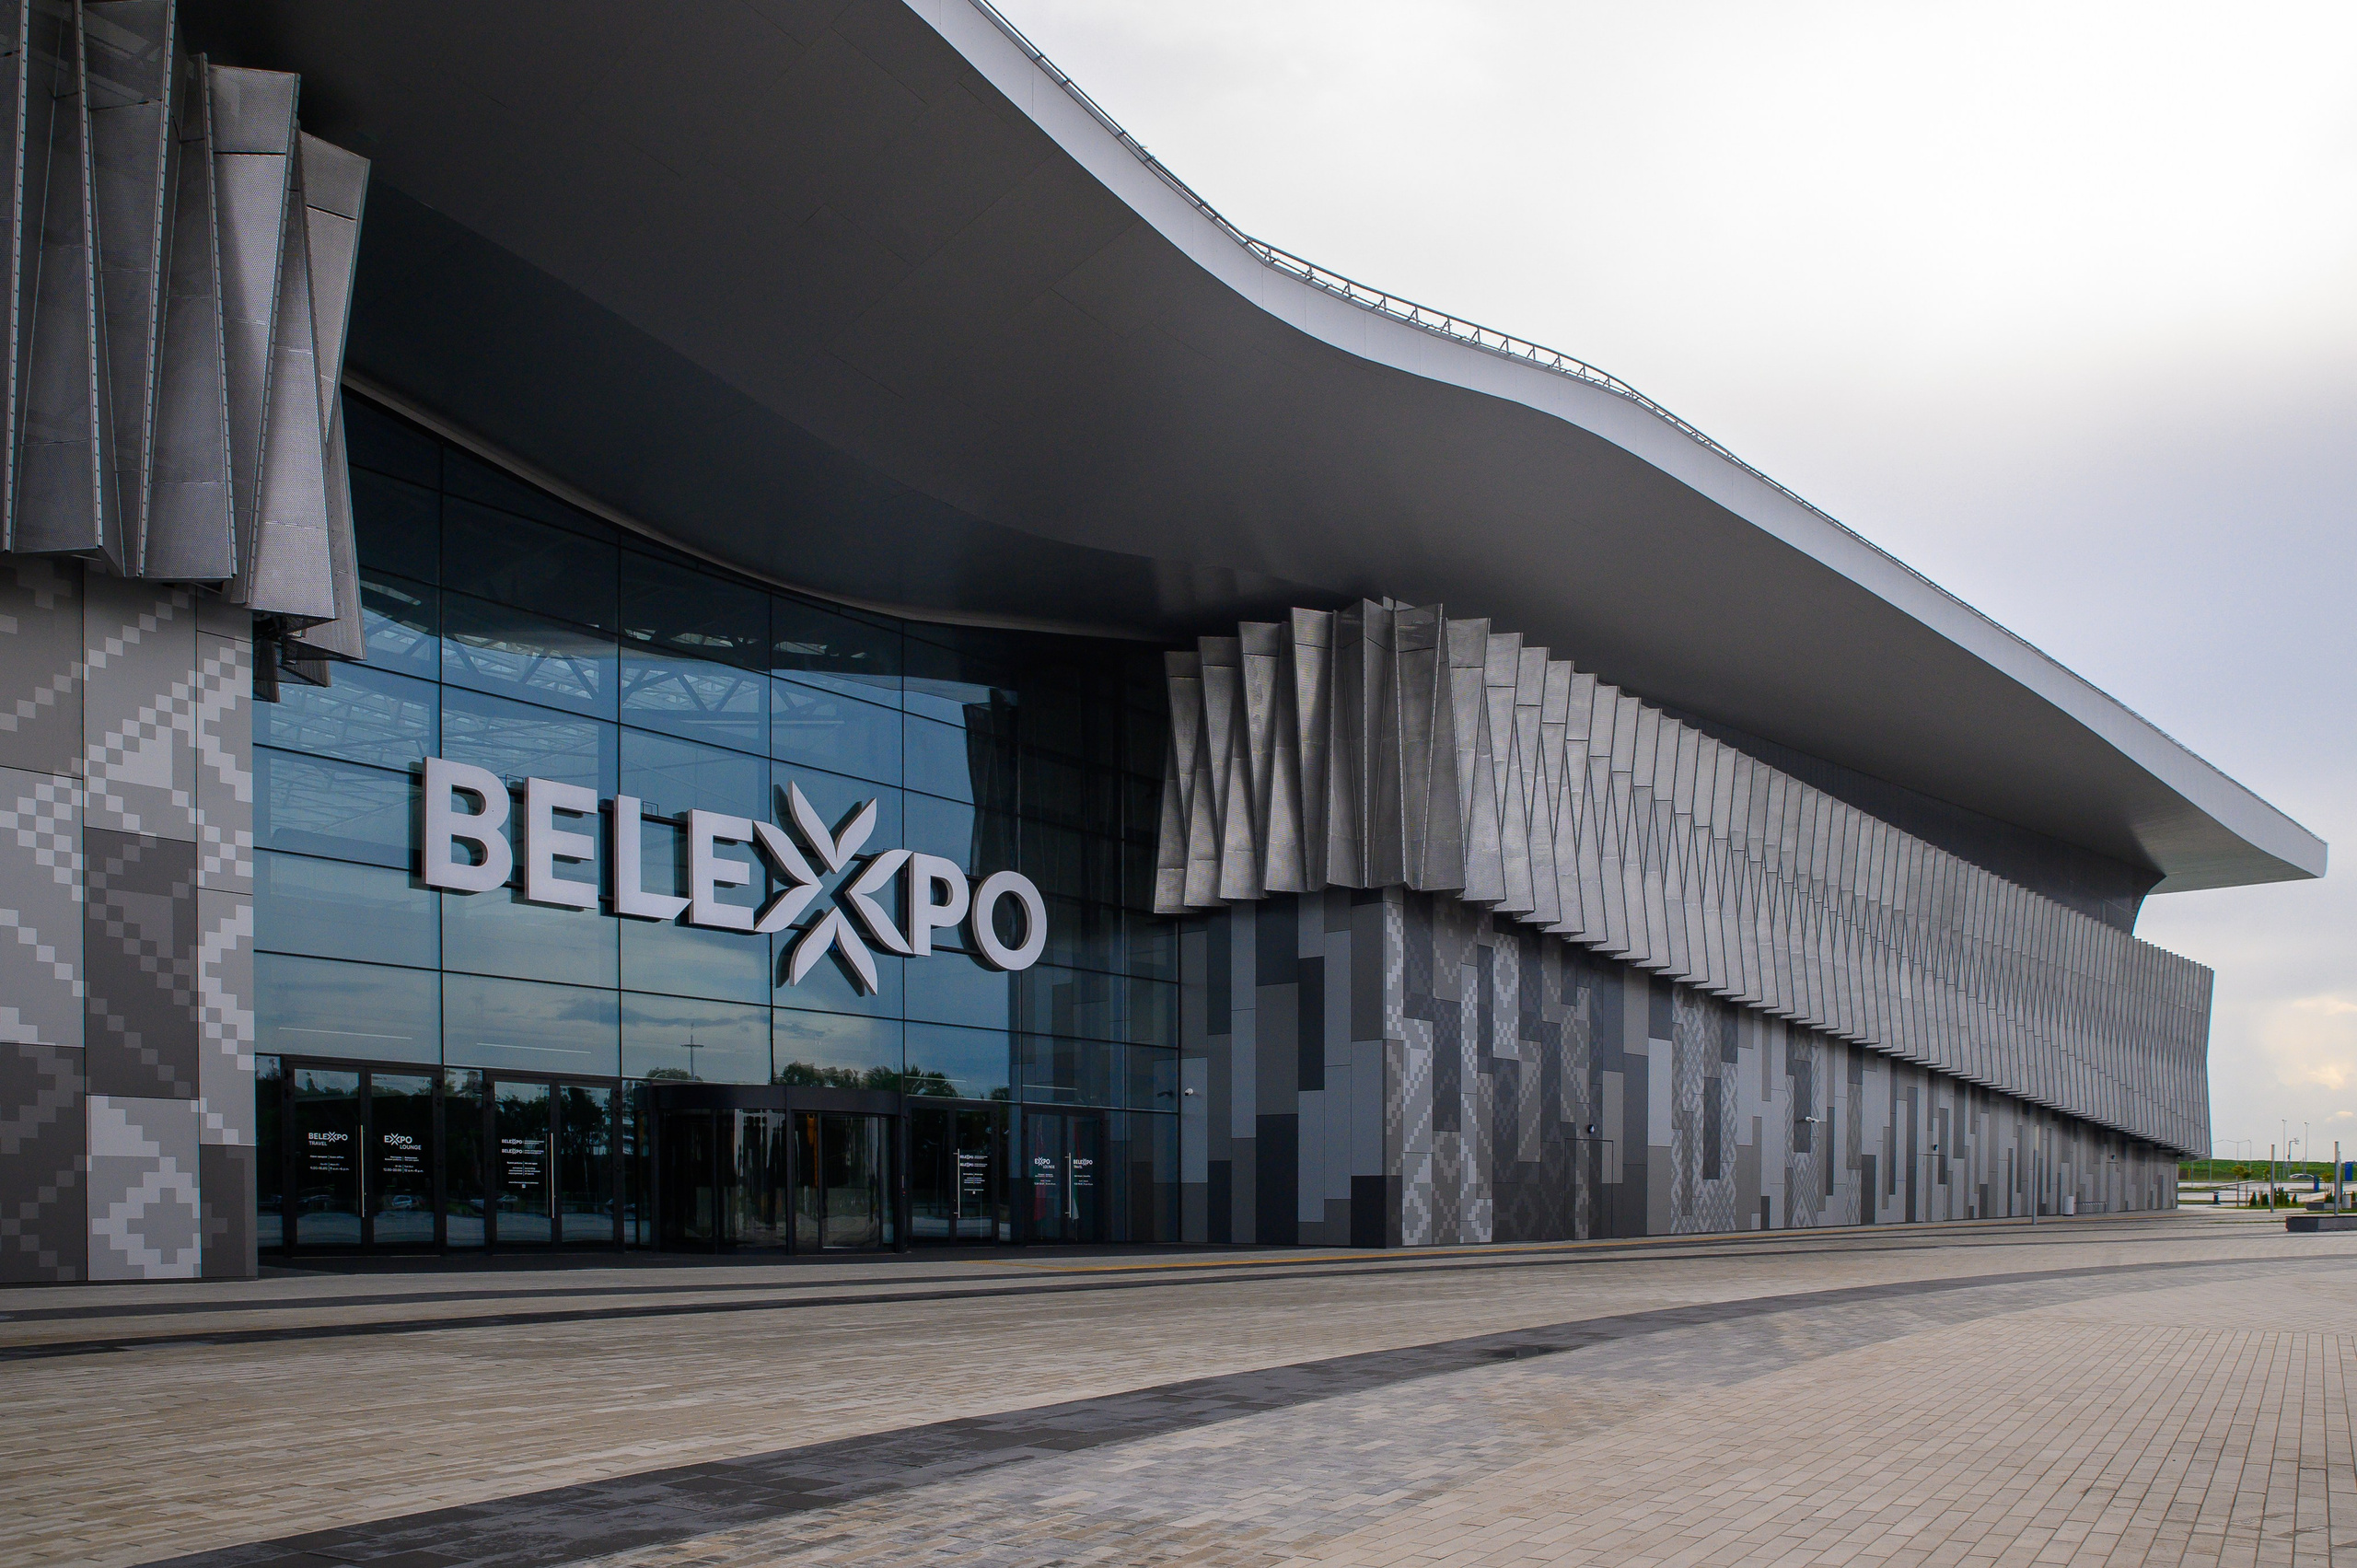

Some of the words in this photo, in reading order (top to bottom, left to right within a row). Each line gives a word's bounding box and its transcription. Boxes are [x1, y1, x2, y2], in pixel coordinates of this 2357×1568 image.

[422, 756, 1048, 996] BELEXPO
[308, 1131, 348, 1143] BELEXPO
[384, 1132, 412, 1145] EXPO
